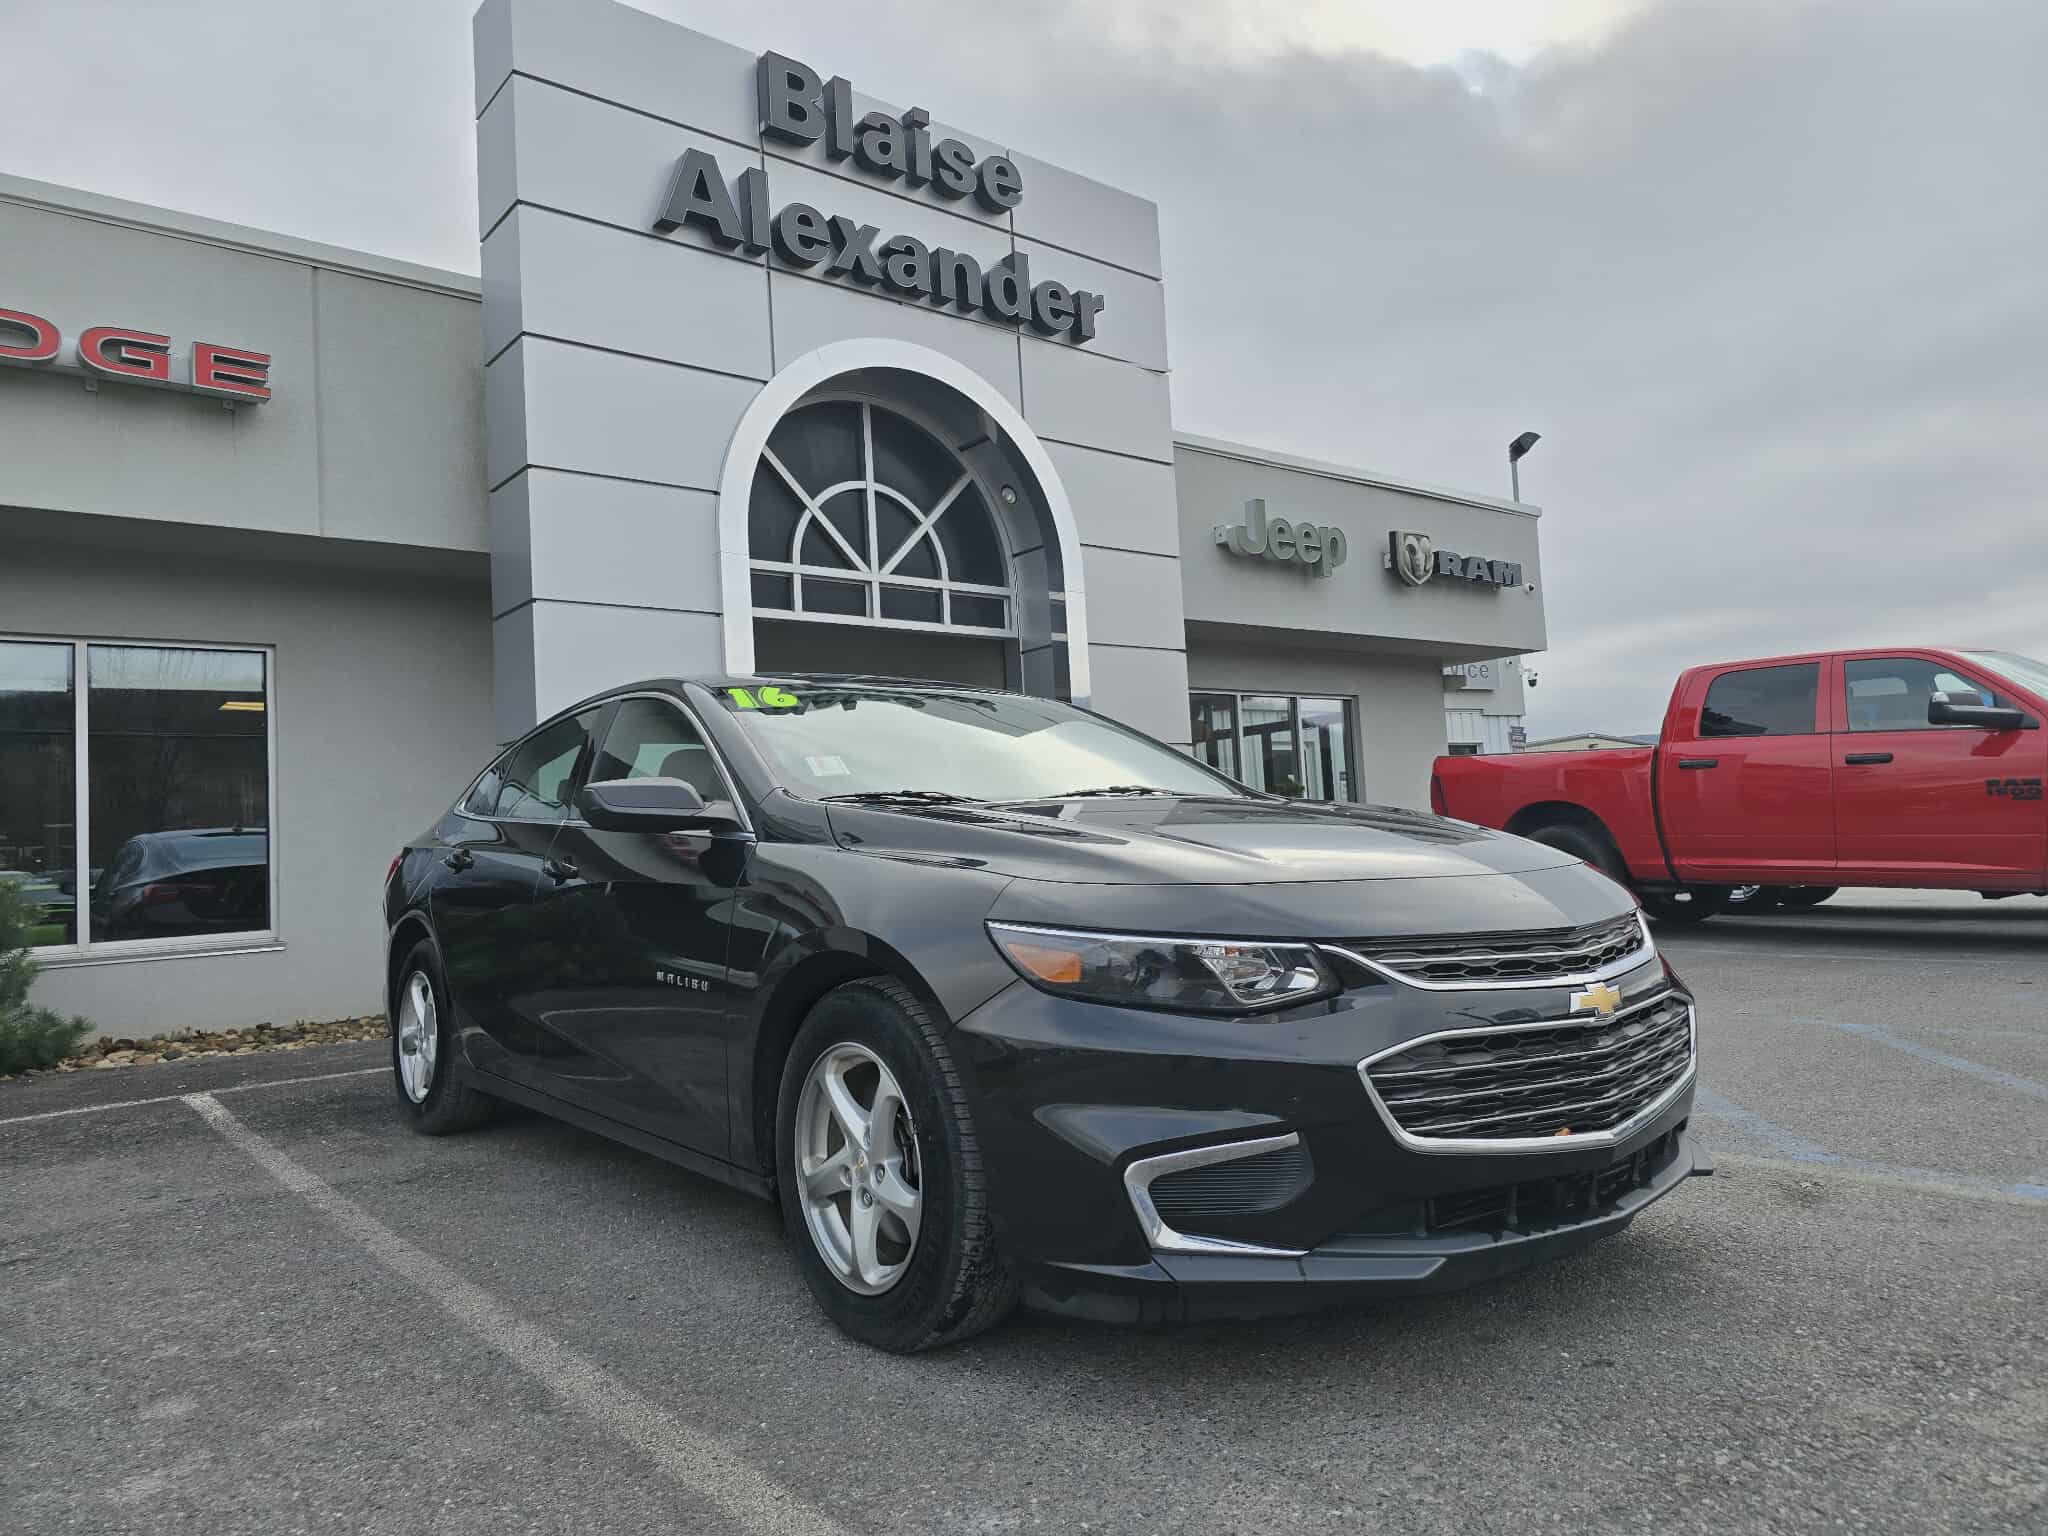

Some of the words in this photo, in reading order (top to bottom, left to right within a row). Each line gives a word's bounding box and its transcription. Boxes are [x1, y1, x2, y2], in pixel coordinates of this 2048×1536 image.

[757, 50, 1023, 213] Blaise
[653, 148, 1104, 344] Alexander
[1228, 498, 1347, 577] Jeep
[1434, 550, 1522, 588] RAM
[727, 686, 799, 708] 16
[656, 971, 708, 992] MALIBU
